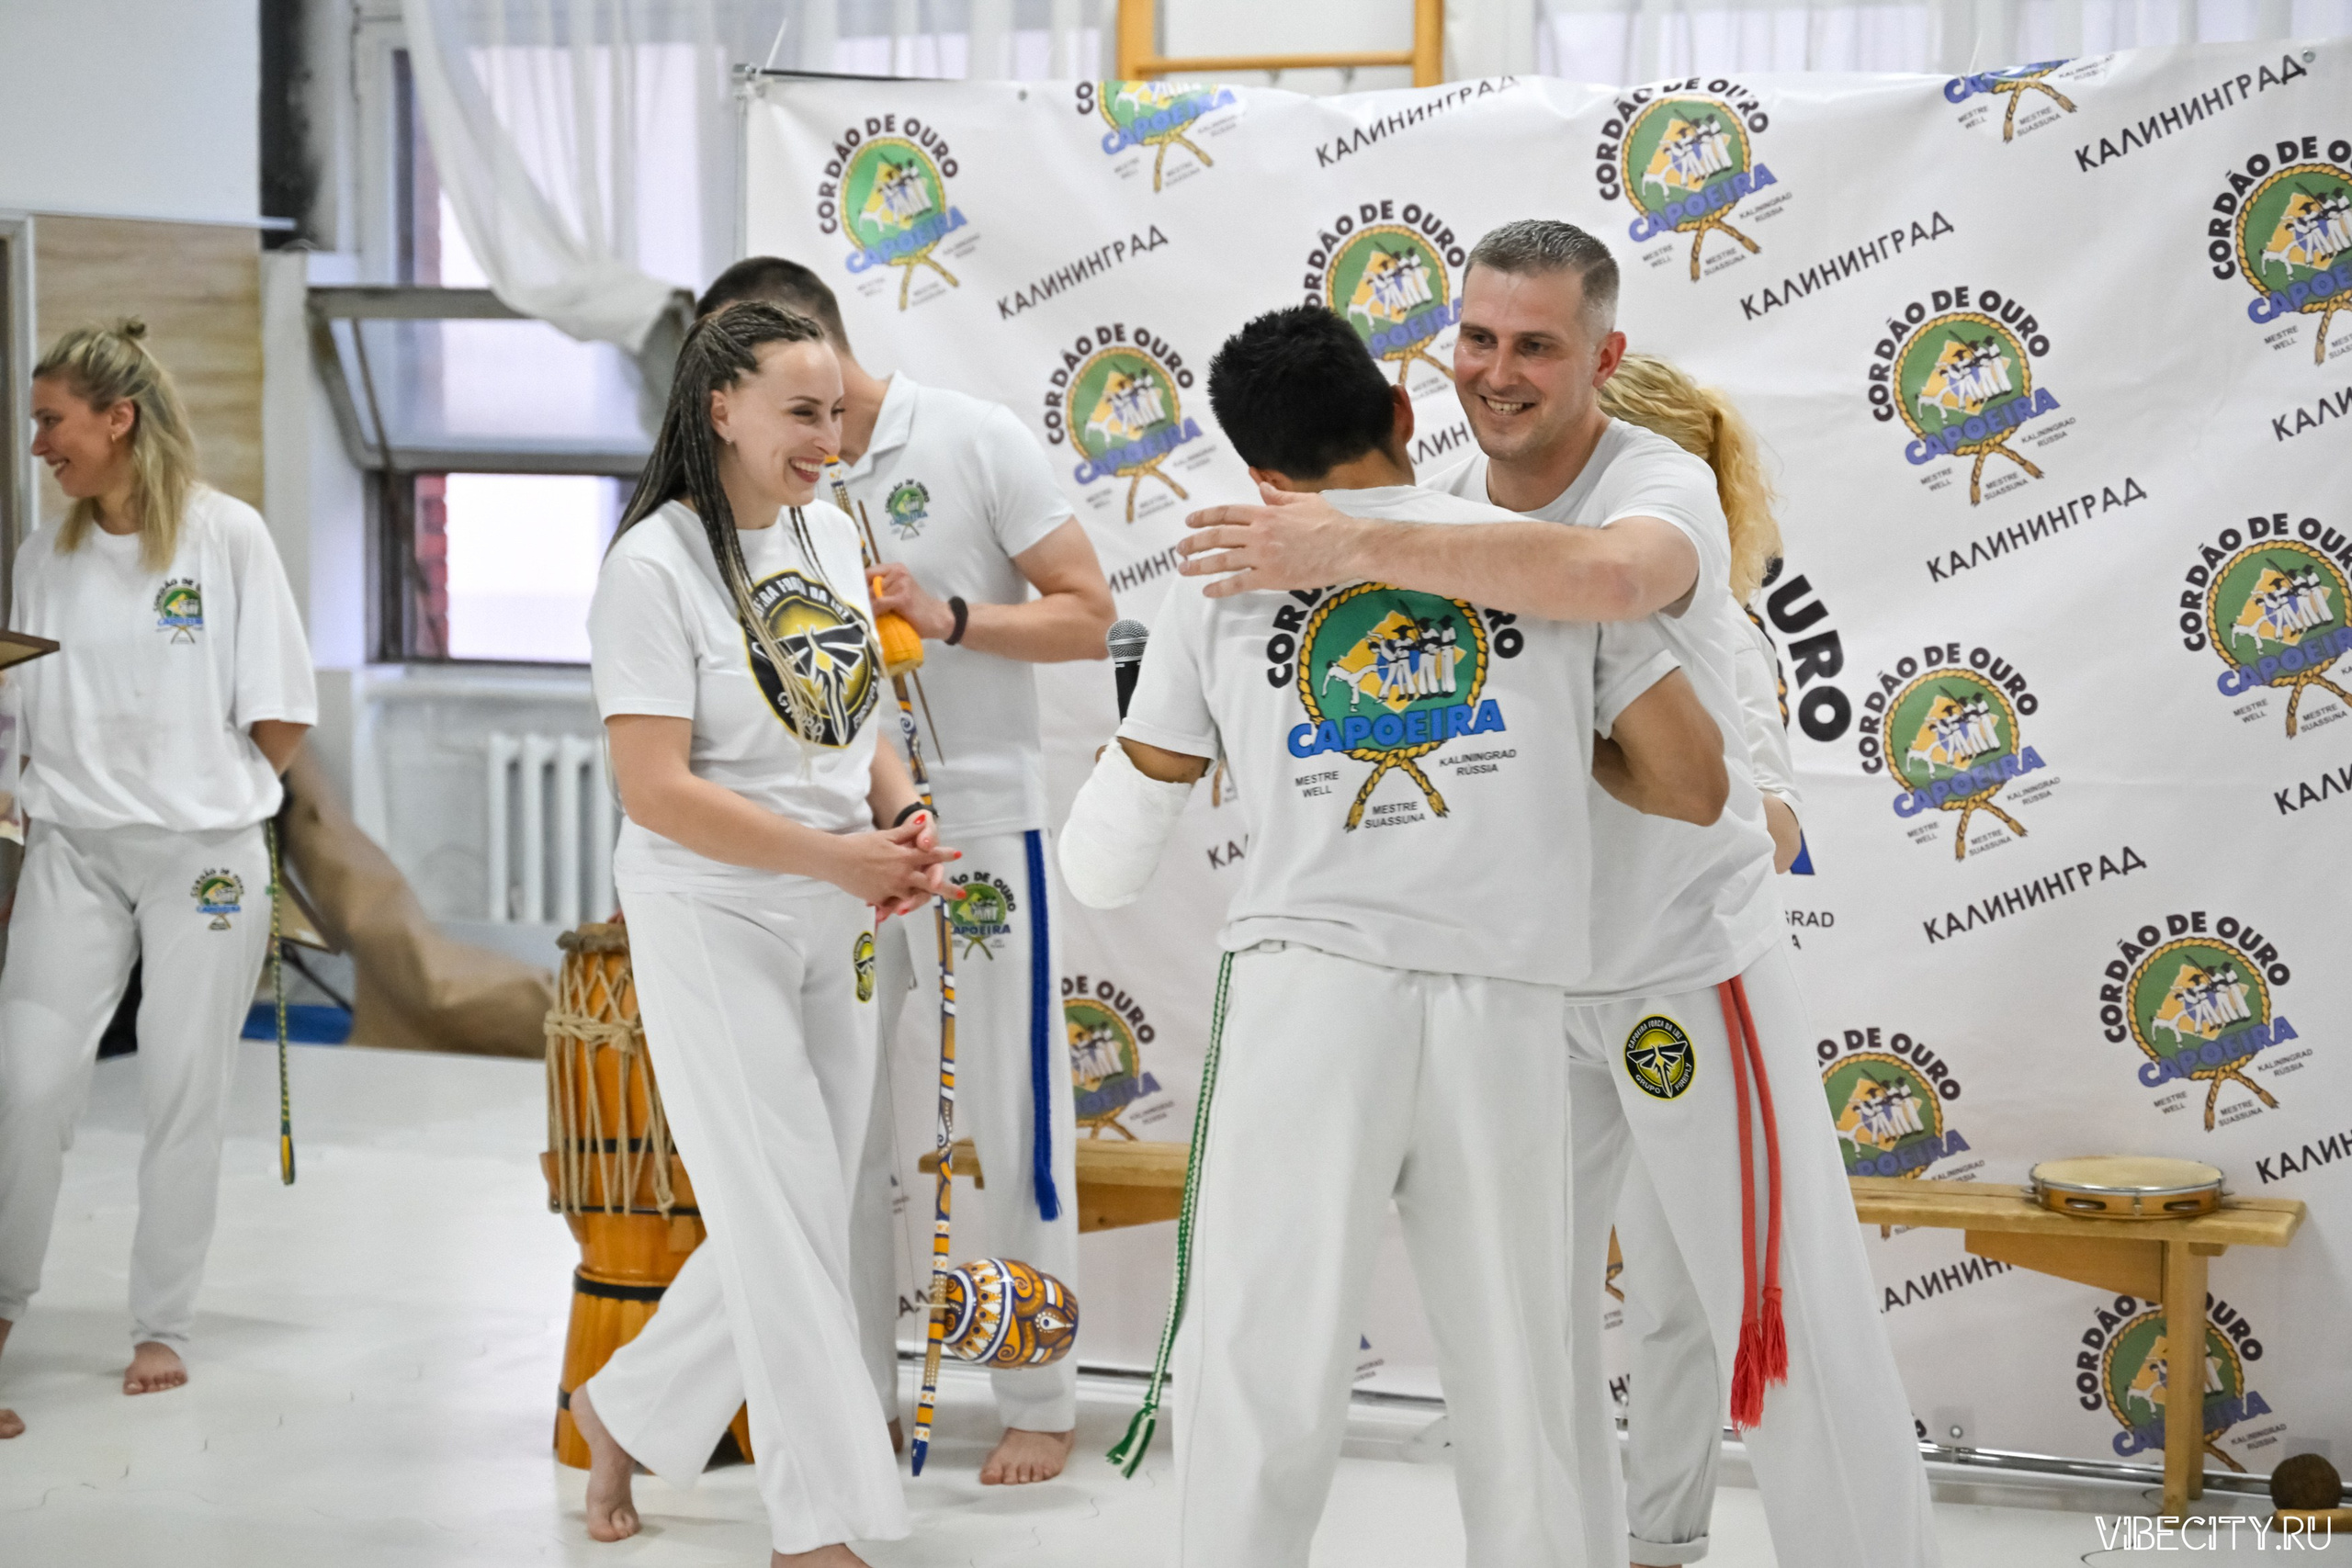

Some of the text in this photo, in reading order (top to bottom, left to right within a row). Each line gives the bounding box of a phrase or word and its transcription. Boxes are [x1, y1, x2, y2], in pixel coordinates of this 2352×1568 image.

[1102, 89, 1237, 155] CAPOEIRA
[2075, 54, 2308, 172] КАЛИНИНГРАД
[817, 114, 959, 235] CORDÃO DE OURO
[1629, 163, 1778, 243] CAPOEIRA
[2208, 136, 2318, 280] CORDÃO DE
[1304, 199, 1466, 309] ORDÃO DE OURO
[1740, 211, 1954, 321] КАЛИНИНГРАД
[997, 224, 1169, 320] КАЛИНИНГРАД
[2264, 324, 2298, 345] MESTRE
[2272, 337, 2298, 351] WELL
[1868, 286, 2051, 423] CORDÃO DE OURO
[1044, 323, 1194, 446] CORDÃO DE OURO
[1905, 387, 2061, 466] CAPOEIRA
[2037, 431, 2068, 448] RUSSIA
[1073, 417, 1204, 486] CAPOEIRA
[1919, 467, 1953, 486] MESTRE
[1928, 479, 1952, 492] WELL
[1984, 472, 2019, 491] MESTRE
[1927, 476, 2149, 583] КАЛИНИНГРАД
[2179, 513, 2352, 652] CORDÃO DE OUR
[1266, 584, 1337, 688] COR
[1859, 643, 2039, 774] CORDÃO DE OURO
[2233, 698, 2268, 717] MESTRE
[2242, 710, 2267, 724] WELL
[2302, 703, 2338, 722] MESTRE
[1287, 698, 1507, 759] CAPOEIRA
[2301, 710, 2347, 733] SUASSUNA
[1439, 748, 1517, 767] KALININGRAD
[1456, 762, 1498, 777] RUSSIA
[1295, 770, 1340, 787] MESTRE
[1302, 784, 1332, 798] WELL
[1893, 746, 2047, 818] CAPOEIRA
[1372, 801, 1418, 815] MESTRE
[2022, 790, 2053, 807] RUSSIA
[1364, 813, 1425, 829] SUASSUNA
[1906, 821, 1939, 840] MESTRE
[1915, 832, 1938, 845] WELL
[1970, 828, 2003, 846] MESTRE
[974, 871, 990, 883] DE
[993, 878, 1017, 912] OURO
[1923, 845, 2147, 944] КАЛИНИНГРАД
[2099, 911, 2290, 1043] CORDÃO DE OURO
[1061, 976, 1156, 1044] DE OURO
[1843, 1027, 1882, 1050] DE
[1890, 1032, 1961, 1100] OURO
[2138, 1015, 2299, 1088] CAPOEIRA
[2256, 1048, 2313, 1073] KALININGRAD
[1675, 1062, 1692, 1091] FIREFLY
[2273, 1062, 2304, 1077] RUSSIA
[1635, 1074, 1661, 1094] GRUPO
[2154, 1091, 2188, 1108] MESTRE
[2162, 1102, 2187, 1115] WELL
[2220, 1100, 2254, 1116] MESTRE
[2218, 1107, 2263, 1127] SUASSUNA
[1880, 1256, 2013, 1314] АЛИНИН
[2076, 1295, 2137, 1411] CORDÃO
